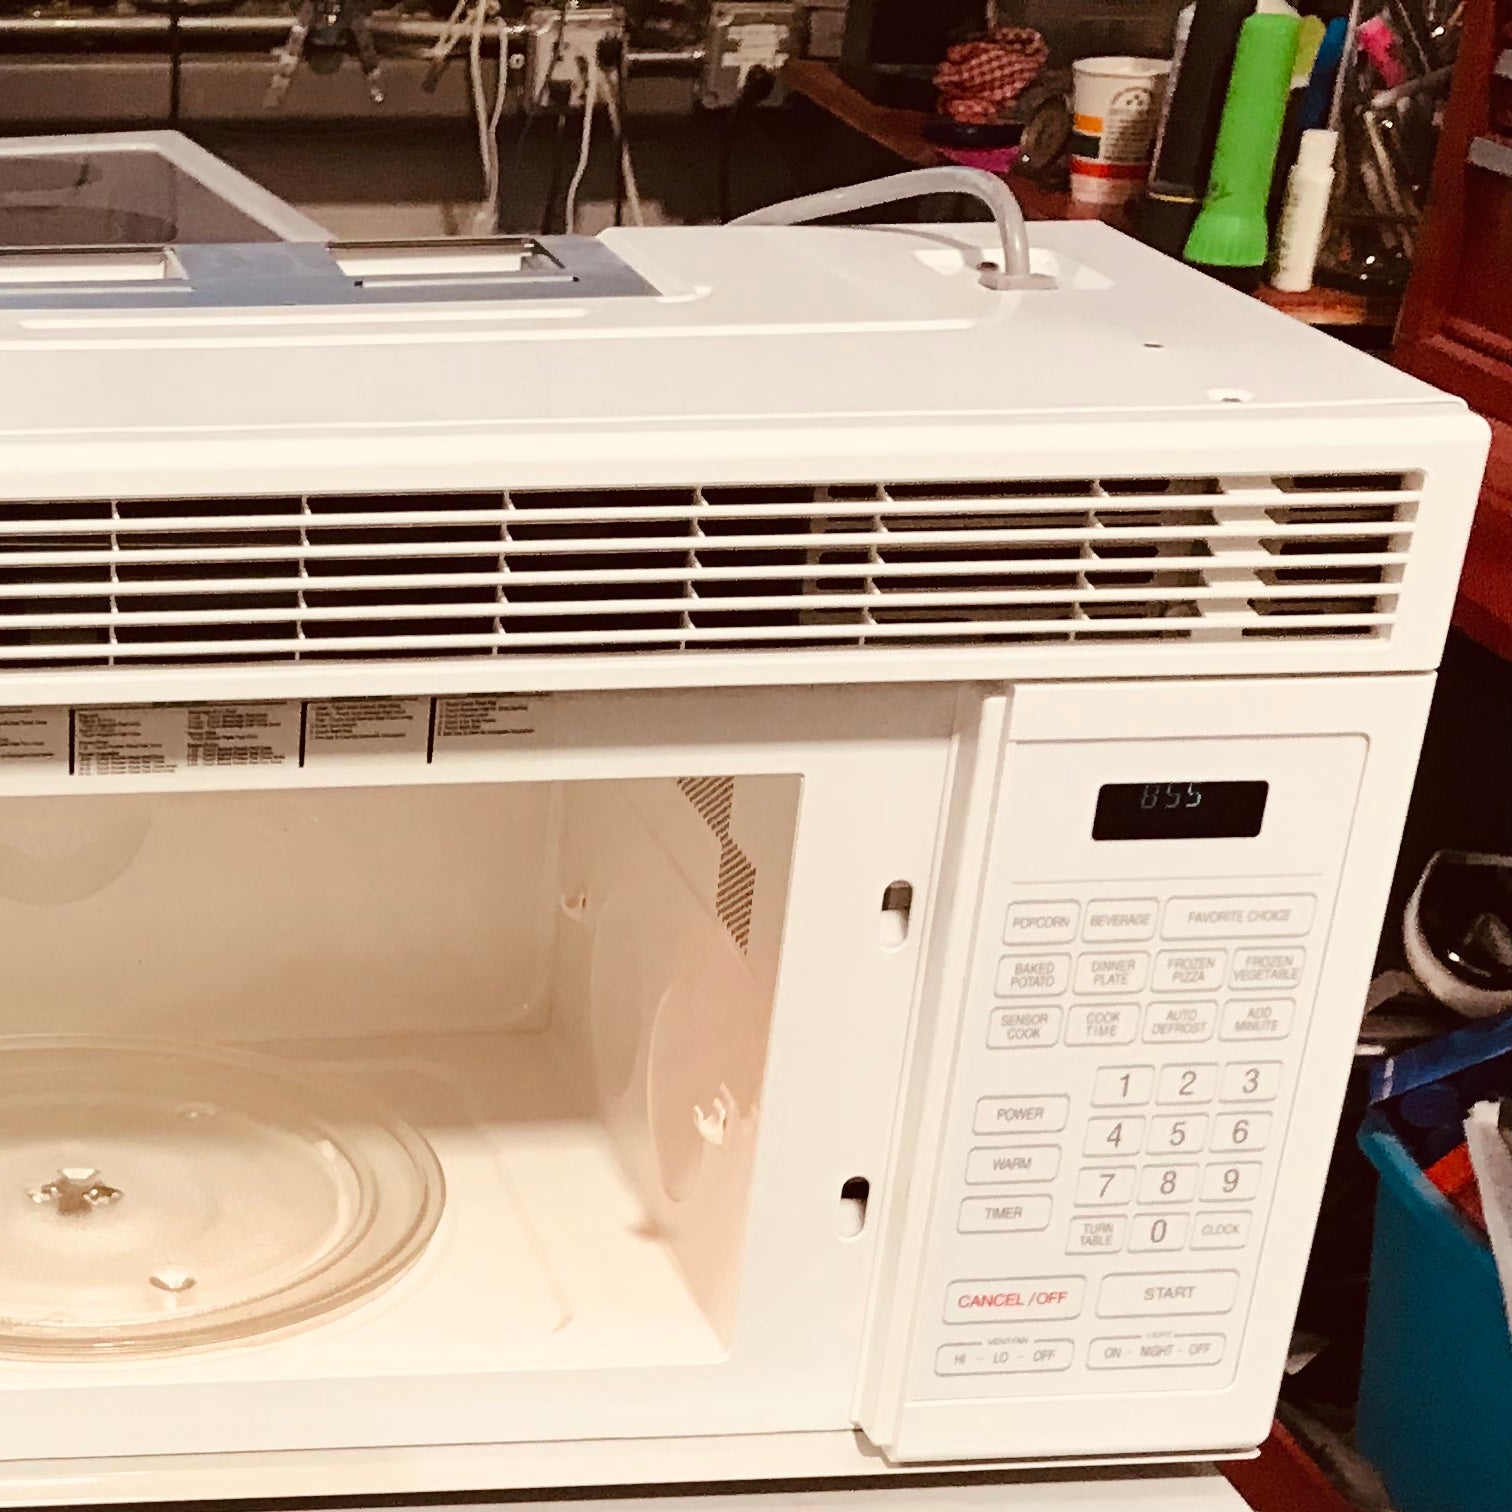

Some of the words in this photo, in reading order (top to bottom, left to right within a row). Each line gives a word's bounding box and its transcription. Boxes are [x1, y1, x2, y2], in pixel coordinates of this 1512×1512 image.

[1012, 915, 1070, 929] POPCORN
[1090, 913, 1151, 927] BEVERAGE
[1188, 910, 1243, 924] FAVORITE
[1246, 909, 1292, 922] CHOICE
[1014, 961, 1055, 975] BAKED
[1091, 959, 1136, 973] DINNER
[1167, 957, 1216, 970] FROZEN
[1246, 955, 1294, 968] FROZEN
[1010, 975, 1055, 988] POTATO
[1093, 972, 1129, 986] PLATE
[1172, 970, 1205, 983] PIZZA
[1233, 968, 1299, 981] VEGETABLE
[1001, 1013, 1048, 1026] SENSOR
[1086, 1012, 1120, 1025] COOK
[1166, 1009, 1198, 1021] AUTO
[1247, 1007, 1272, 1019] ADD
[1086, 1025, 1118, 1037] TIME
[1152, 1022, 1207, 1035] DEFROST
[1235, 1020, 1279, 1032] MINUTE
[1007, 1027, 1041, 1040] COOK
[1118, 1071, 1131, 1098] 1
[1178, 1070, 1197, 1097] 2
[1241, 1067, 1260, 1095] 3
[996, 1107, 1044, 1121] POWER
[1106, 1121, 1123, 1149] 4
[1169, 1120, 1187, 1147] 5
[1231, 1118, 1249, 1145] 6
[992, 1156, 1033, 1171] WARM
[1098, 1173, 1116, 1199] 7
[1160, 1169, 1178, 1196] 8
[1222, 1167, 1240, 1193] 9
[984, 1206, 1023, 1220] TIMER
[1082, 1222, 1114, 1235] TURN
[1150, 1218, 1168, 1244] 0
[1200, 1222, 1240, 1236] CLOCK
[1080, 1234, 1113, 1247] TABLE
[1143, 1286, 1196, 1301] START
[953, 1353, 966, 1365] HI
[992, 1351, 1009, 1364] LO
[1032, 1350, 1057, 1363] OFF
[1103, 1347, 1122, 1359] ON
[1140, 1345, 1175, 1358] NIGHT
[1187, 1343, 1213, 1356] OFF
